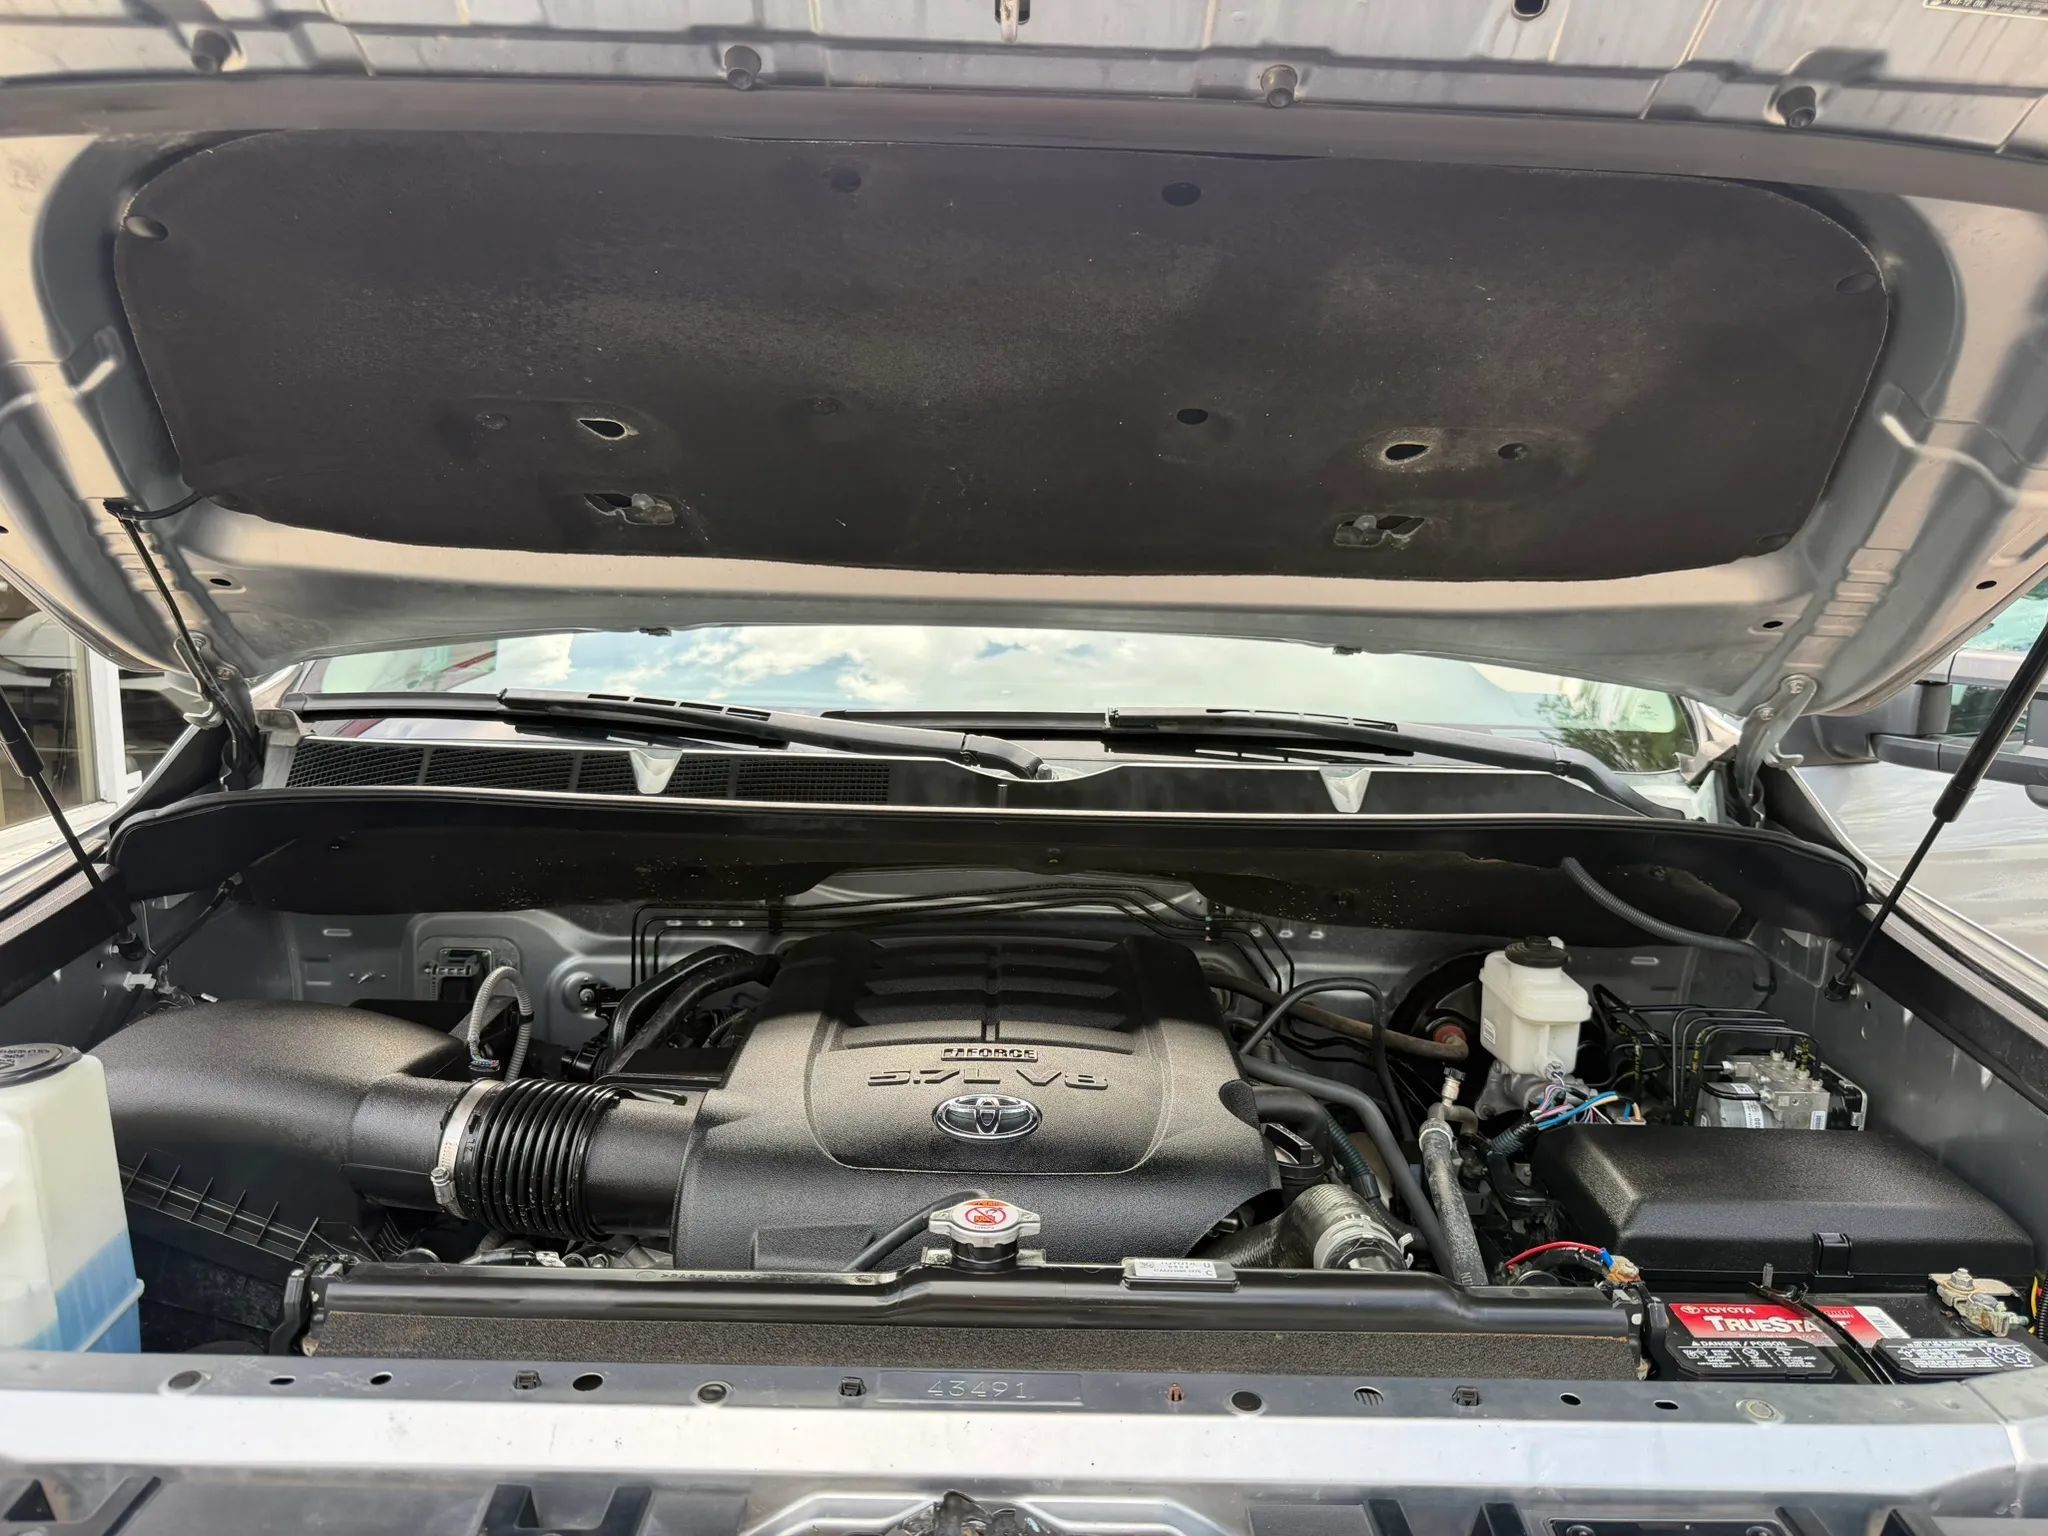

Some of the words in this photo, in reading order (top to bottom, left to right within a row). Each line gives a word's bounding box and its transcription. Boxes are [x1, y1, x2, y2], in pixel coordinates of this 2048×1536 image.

[868, 1066, 1001, 1087] 5.7L
[1016, 1067, 1109, 1090] V8
[1703, 1306, 1756, 1315] TOYOTA
[927, 1380, 1027, 1399] 43491
